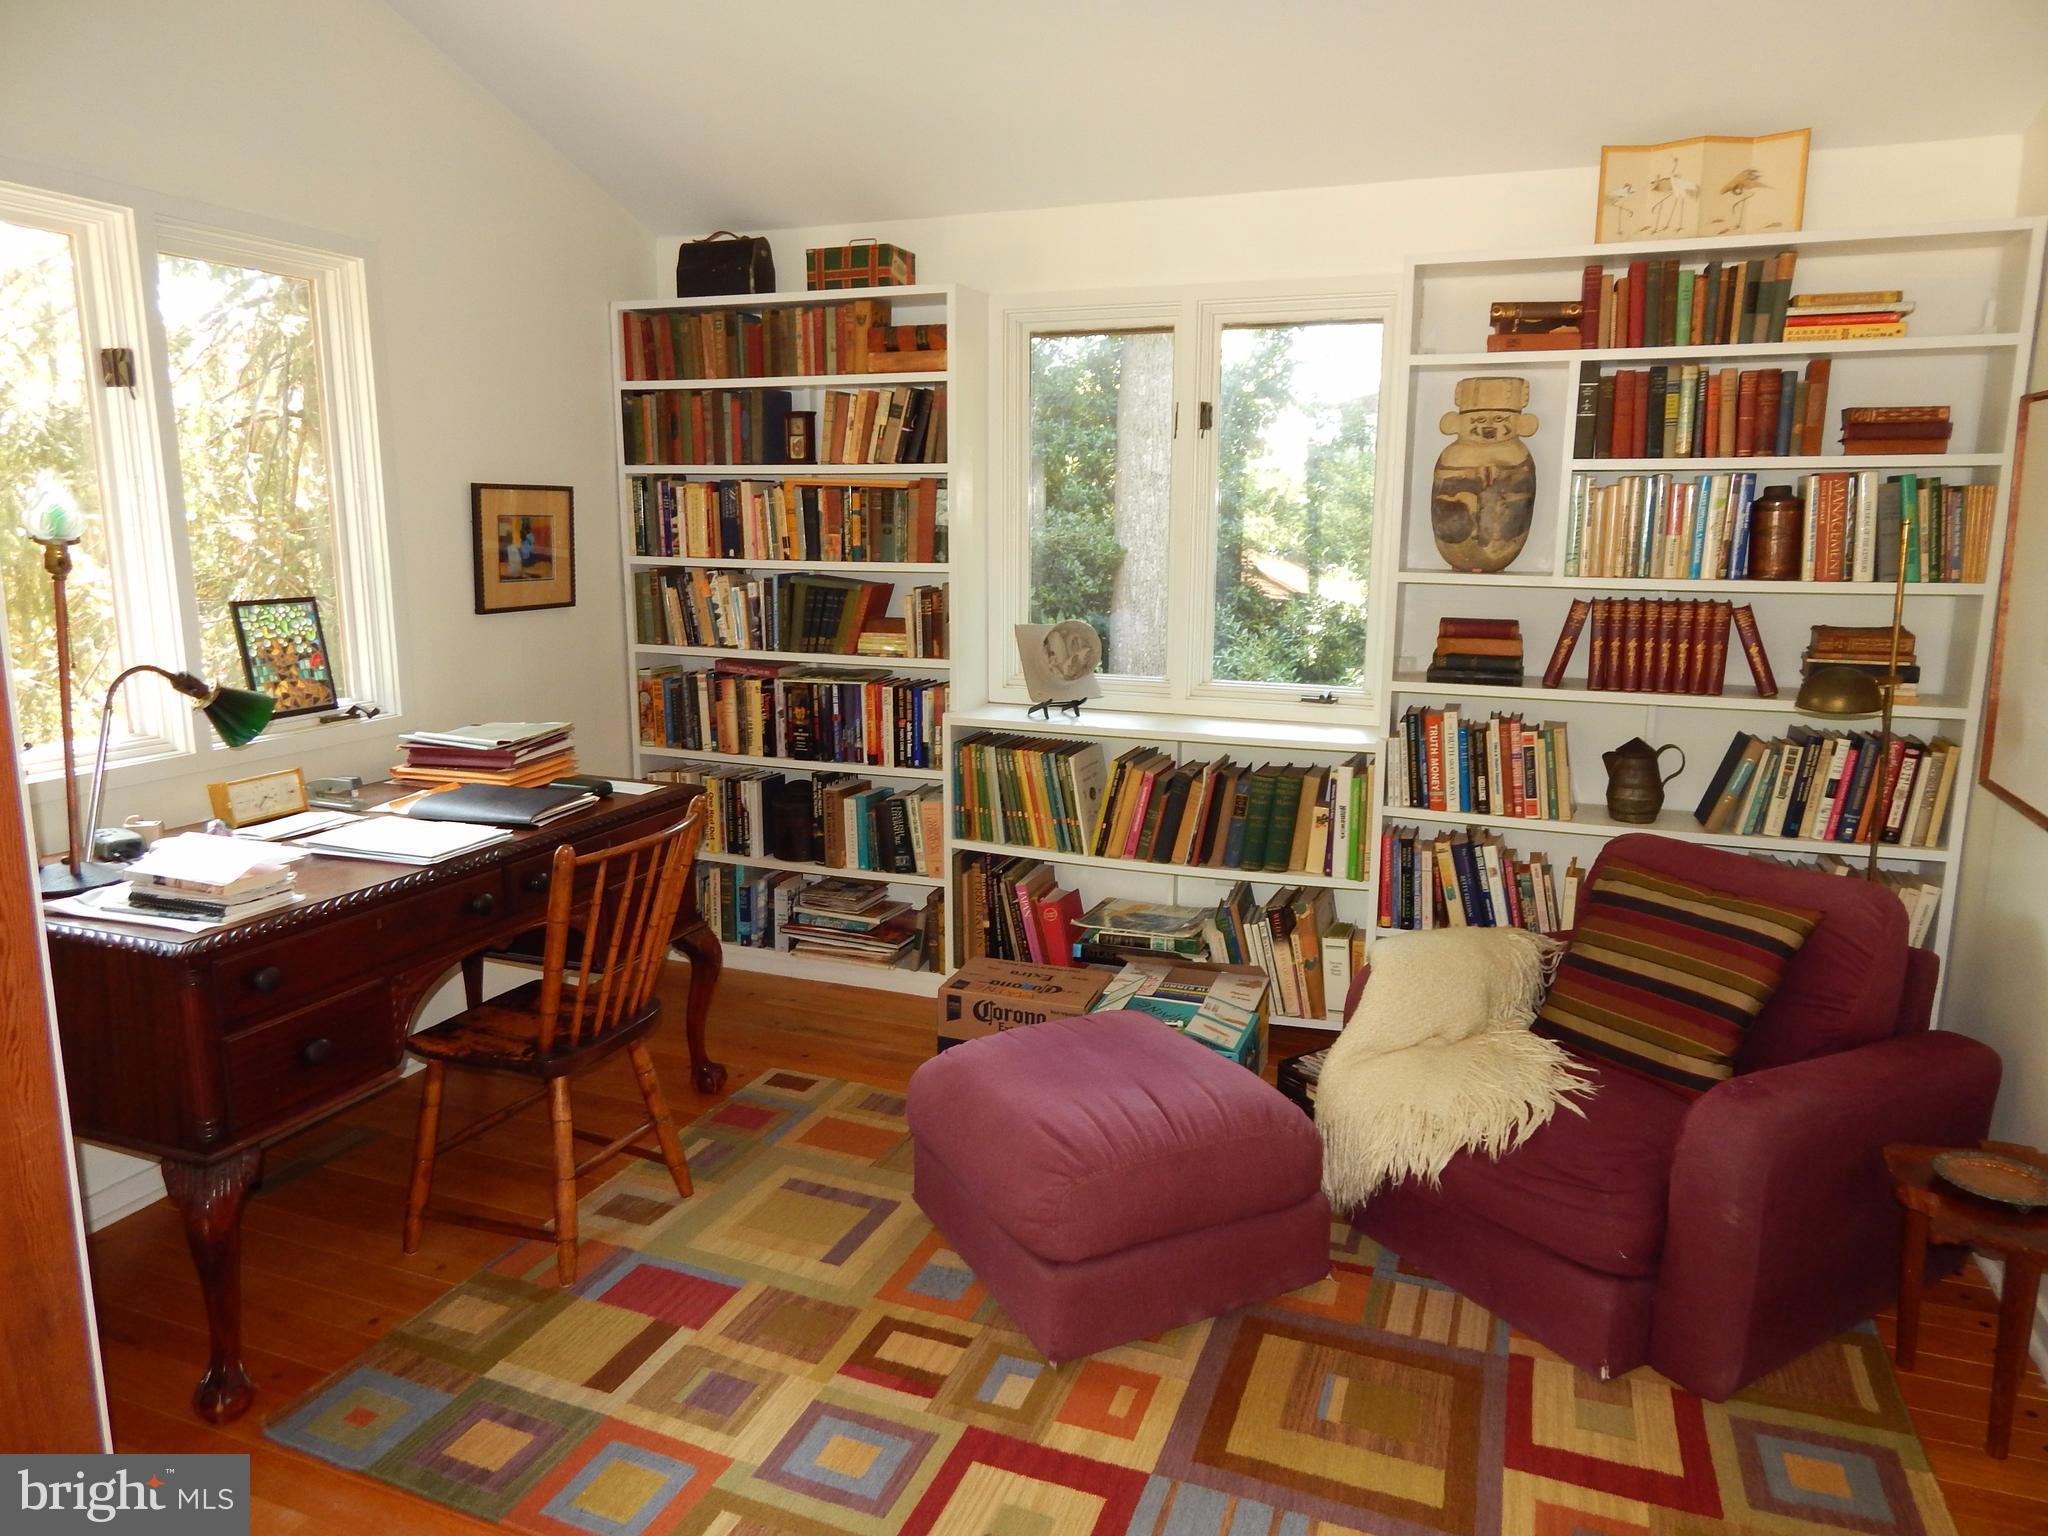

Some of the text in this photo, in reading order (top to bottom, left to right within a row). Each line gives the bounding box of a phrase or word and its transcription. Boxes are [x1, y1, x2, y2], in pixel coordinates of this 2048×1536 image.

[1827, 479, 1846, 577] MANAGEMENT
[1429, 724, 1440, 791] TRUTH MONEY
[891, 806, 901, 846] LITERATURE
[896, 805, 905, 837] ENGLISH
[1019, 891, 1032, 918] JAPAN
[990, 978, 1063, 994] Coona
[1009, 969, 1053, 982] Extra
[972, 999, 1047, 1026] Corona
